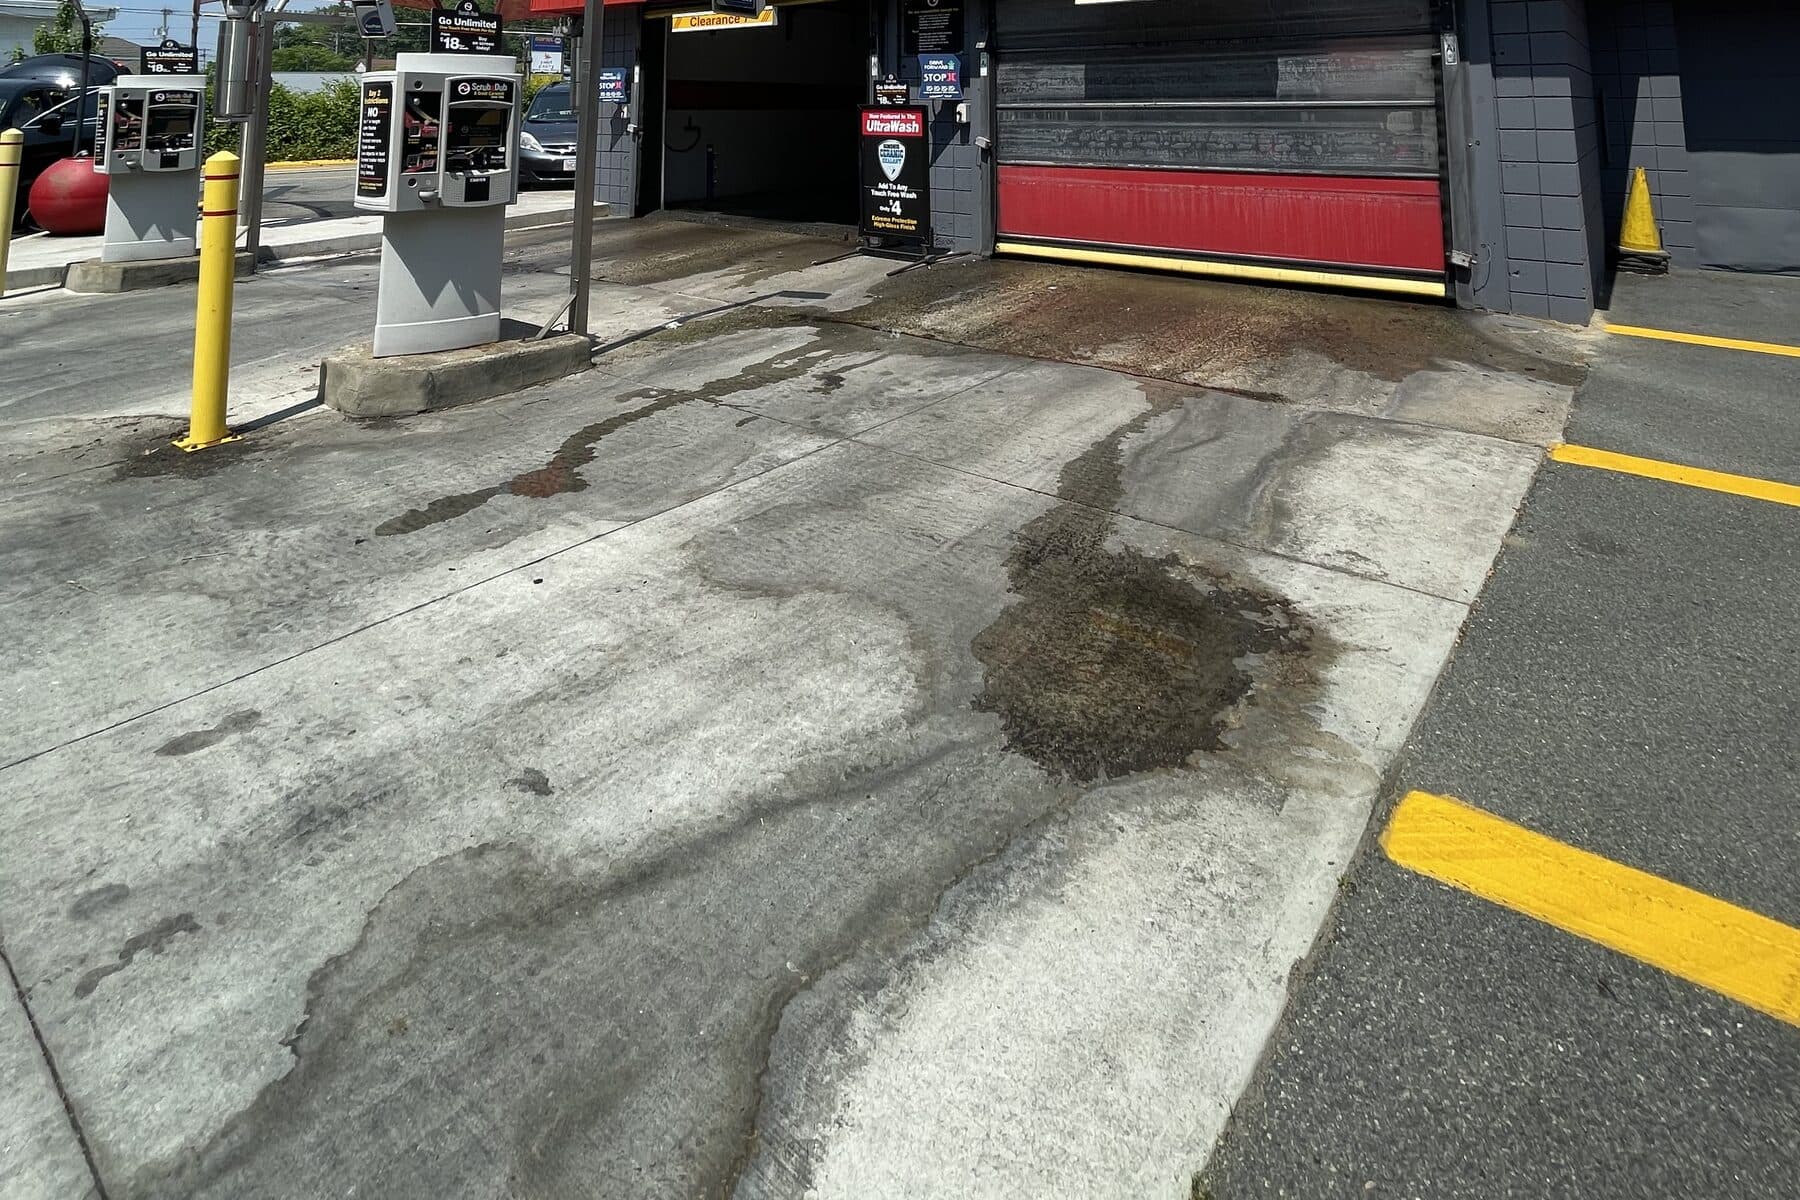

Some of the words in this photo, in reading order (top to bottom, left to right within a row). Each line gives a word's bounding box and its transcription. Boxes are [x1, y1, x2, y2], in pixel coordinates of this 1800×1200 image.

[439, 17, 452, 25] Go
[454, 18, 497, 29] Unlimited
[690, 16, 740, 27] Clearance
[440, 36, 460, 50] $18
[923, 73, 947, 81] STOP
[367, 107, 379, 117] NO
[866, 120, 919, 133] UltraWash
[887, 190, 899, 198] Free
[900, 191, 917, 199] Wash
[889, 199, 902, 215] $4
